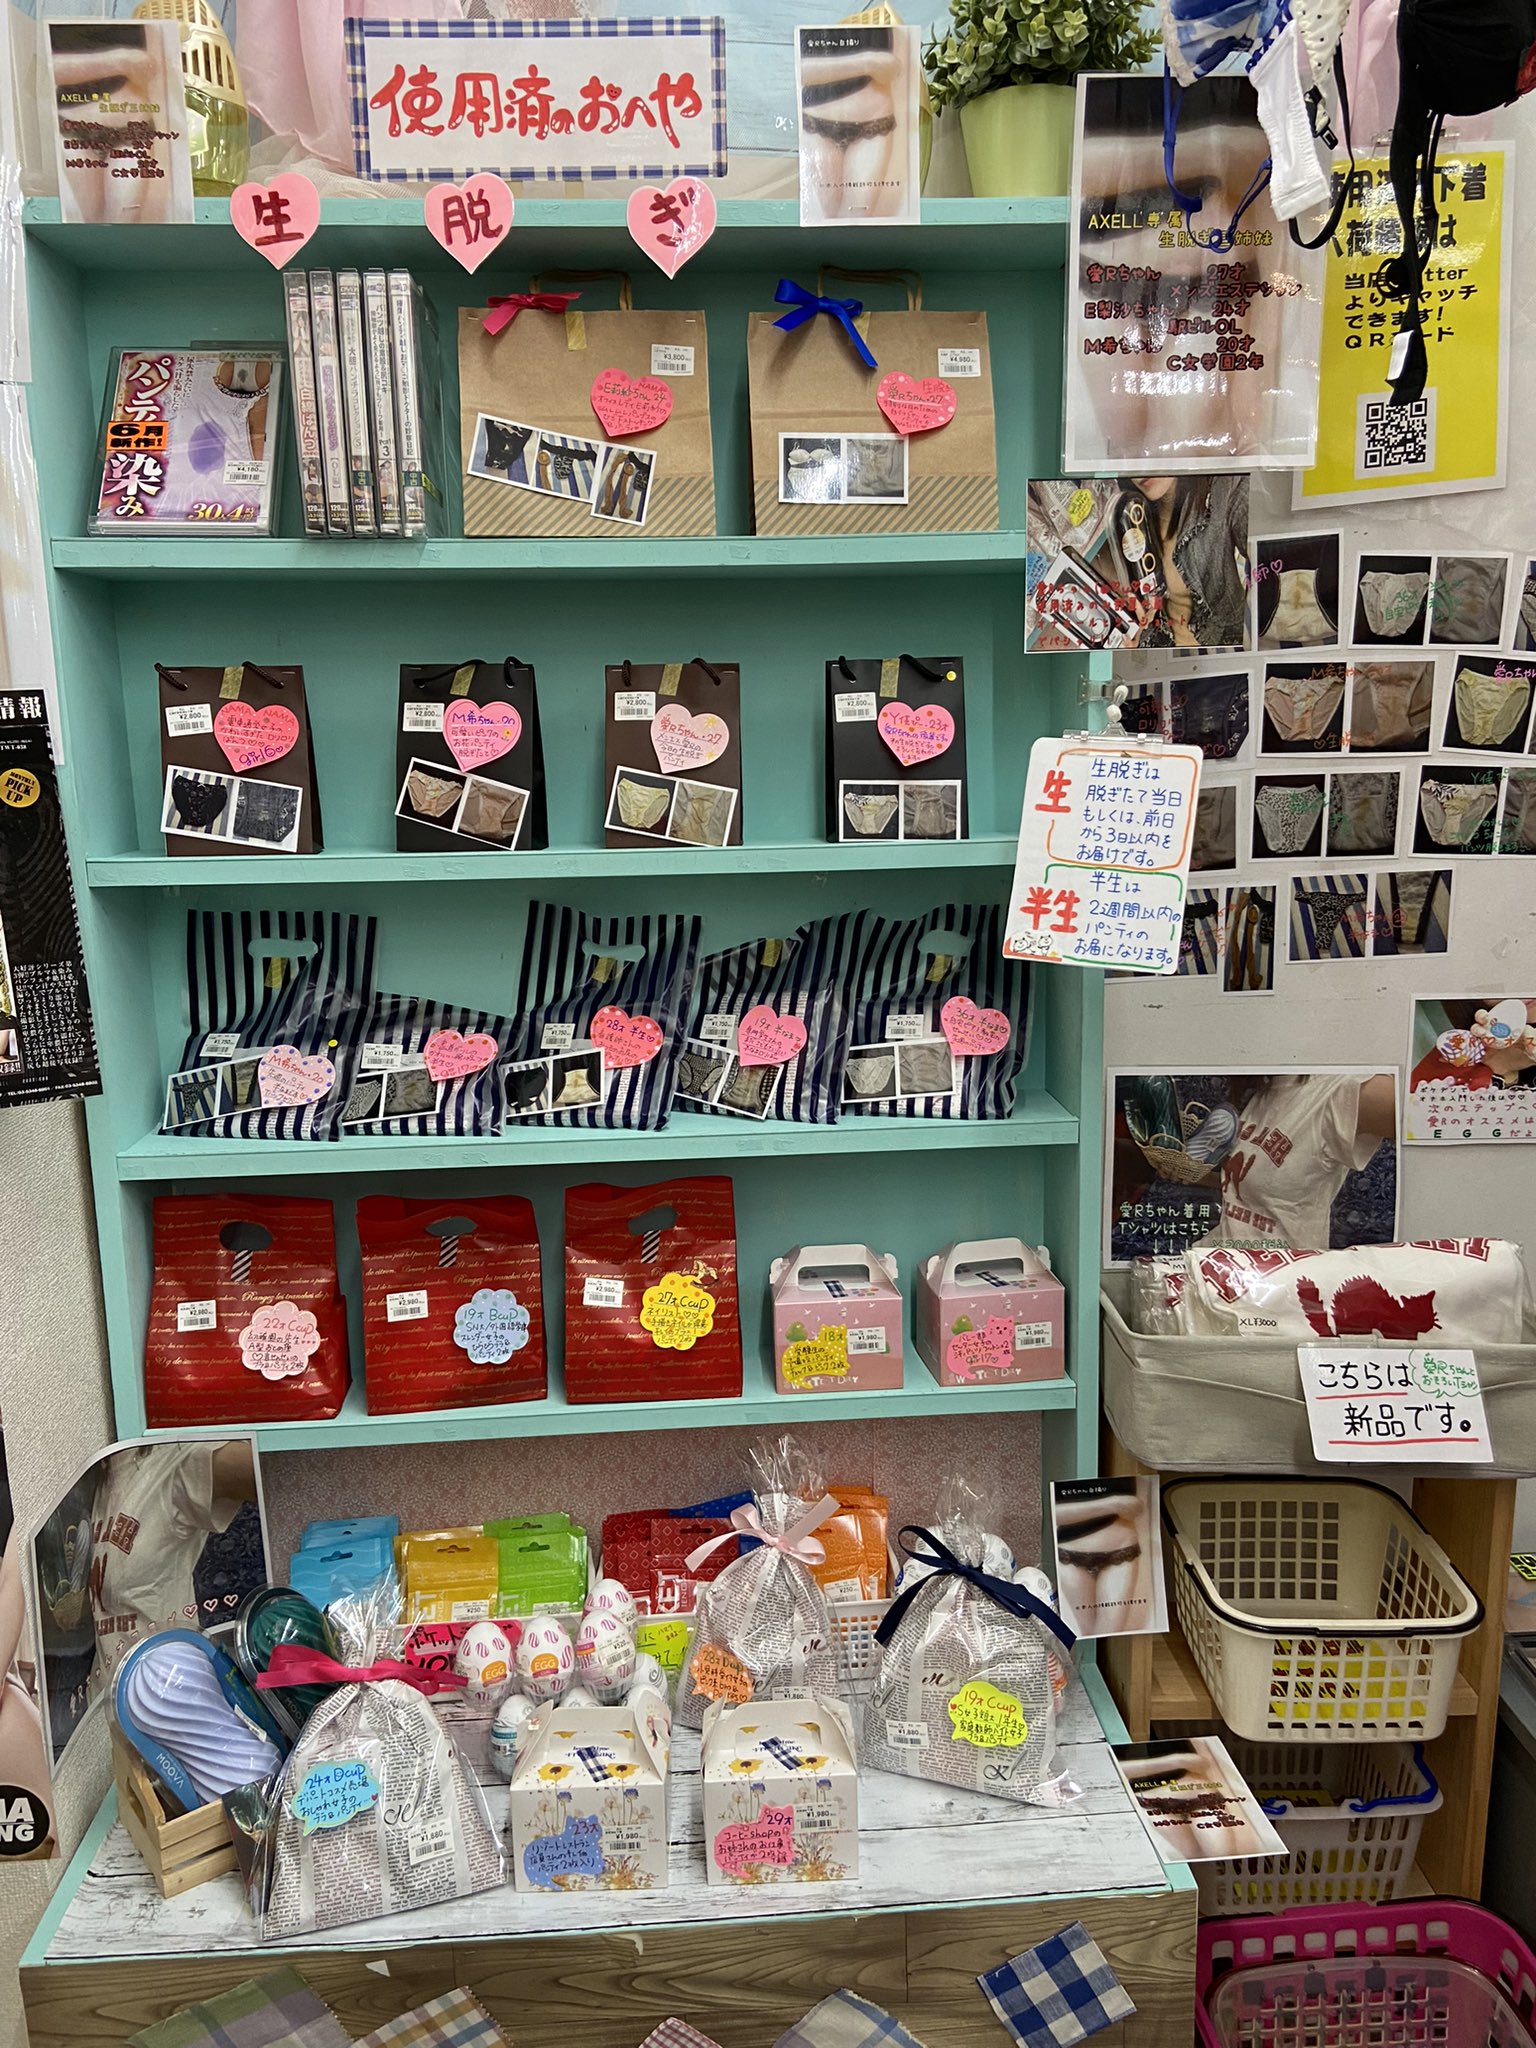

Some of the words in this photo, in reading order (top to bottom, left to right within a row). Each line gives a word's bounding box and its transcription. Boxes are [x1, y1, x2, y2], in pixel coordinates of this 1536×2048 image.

[369, 63, 703, 149] 使用済のおへや
[253, 193, 305, 247] 生
[442, 189, 503, 247] 脱
[651, 187, 698, 249] ぎ
[1087, 212, 1144, 230] AXELL
[1086, 263, 1162, 282] 愛Rちゃん
[1207, 262, 1246, 282] 27才
[1211, 301, 1251, 317] 24才
[1216, 334, 1255, 353] 20才
[664, 353, 685, 361] ¥3,800
[1166, 353, 1264, 371] C女学園2年
[109, 423, 165, 437] 6月
[110, 437, 164, 449] 新作!
[847, 699, 868, 707] ¥2,800
[180, 712, 201, 720] ¥2,800
[1091, 758, 1161, 780] 生脱ぎは
[5, 777, 34, 797] PICK
[1035, 770, 1072, 813] 生
[1085, 784, 1183, 808] 脱ぎたて当日
[5, 790, 24, 804] UP
[1082, 808, 1175, 829] もしくは、前日
[1079, 827, 1172, 849] から3日以内を
[1076, 844, 1155, 868] お届けです。
[1089, 871, 1142, 894] 半生は
[1020, 886, 1081, 933] 半生
[1089, 899, 1182, 923] 2週間以内の
[1085, 922, 1149, 941] パンティの
[1073, 937, 1173, 965] お届になります。
[956, 1006, 974, 1021] 36才
[605, 1018, 626, 1032] 28才
[754, 1017, 772, 1030] 19才
[1119, 1202, 1211, 1219] 愛Rちゃん着用
[1118, 1221, 1211, 1236] Tシャツはこちら
[657, 1291, 678, 1304] 27才
[464, 1308, 485, 1320] 19才
[262, 1317, 285, 1330] 22才
[823, 1330, 844, 1342] 18才
[1316, 1359, 1414, 1390] こちらは
[1343, 1401, 1472, 1439] 新品です。
[839, 1586, 854, 1594] ¥250
[485, 1665, 506, 1680] EGG
[534, 1659, 556, 1670] EGG
[964, 1690, 984, 1708] 19才
[156, 1752, 186, 1789] MOOVA
[305, 1773, 331, 1789] 24才
[300, 1794, 357, 1817] おしゃれ女子の
[572, 1821, 599, 1835] 23才
[766, 1812, 793, 1826] 29才
